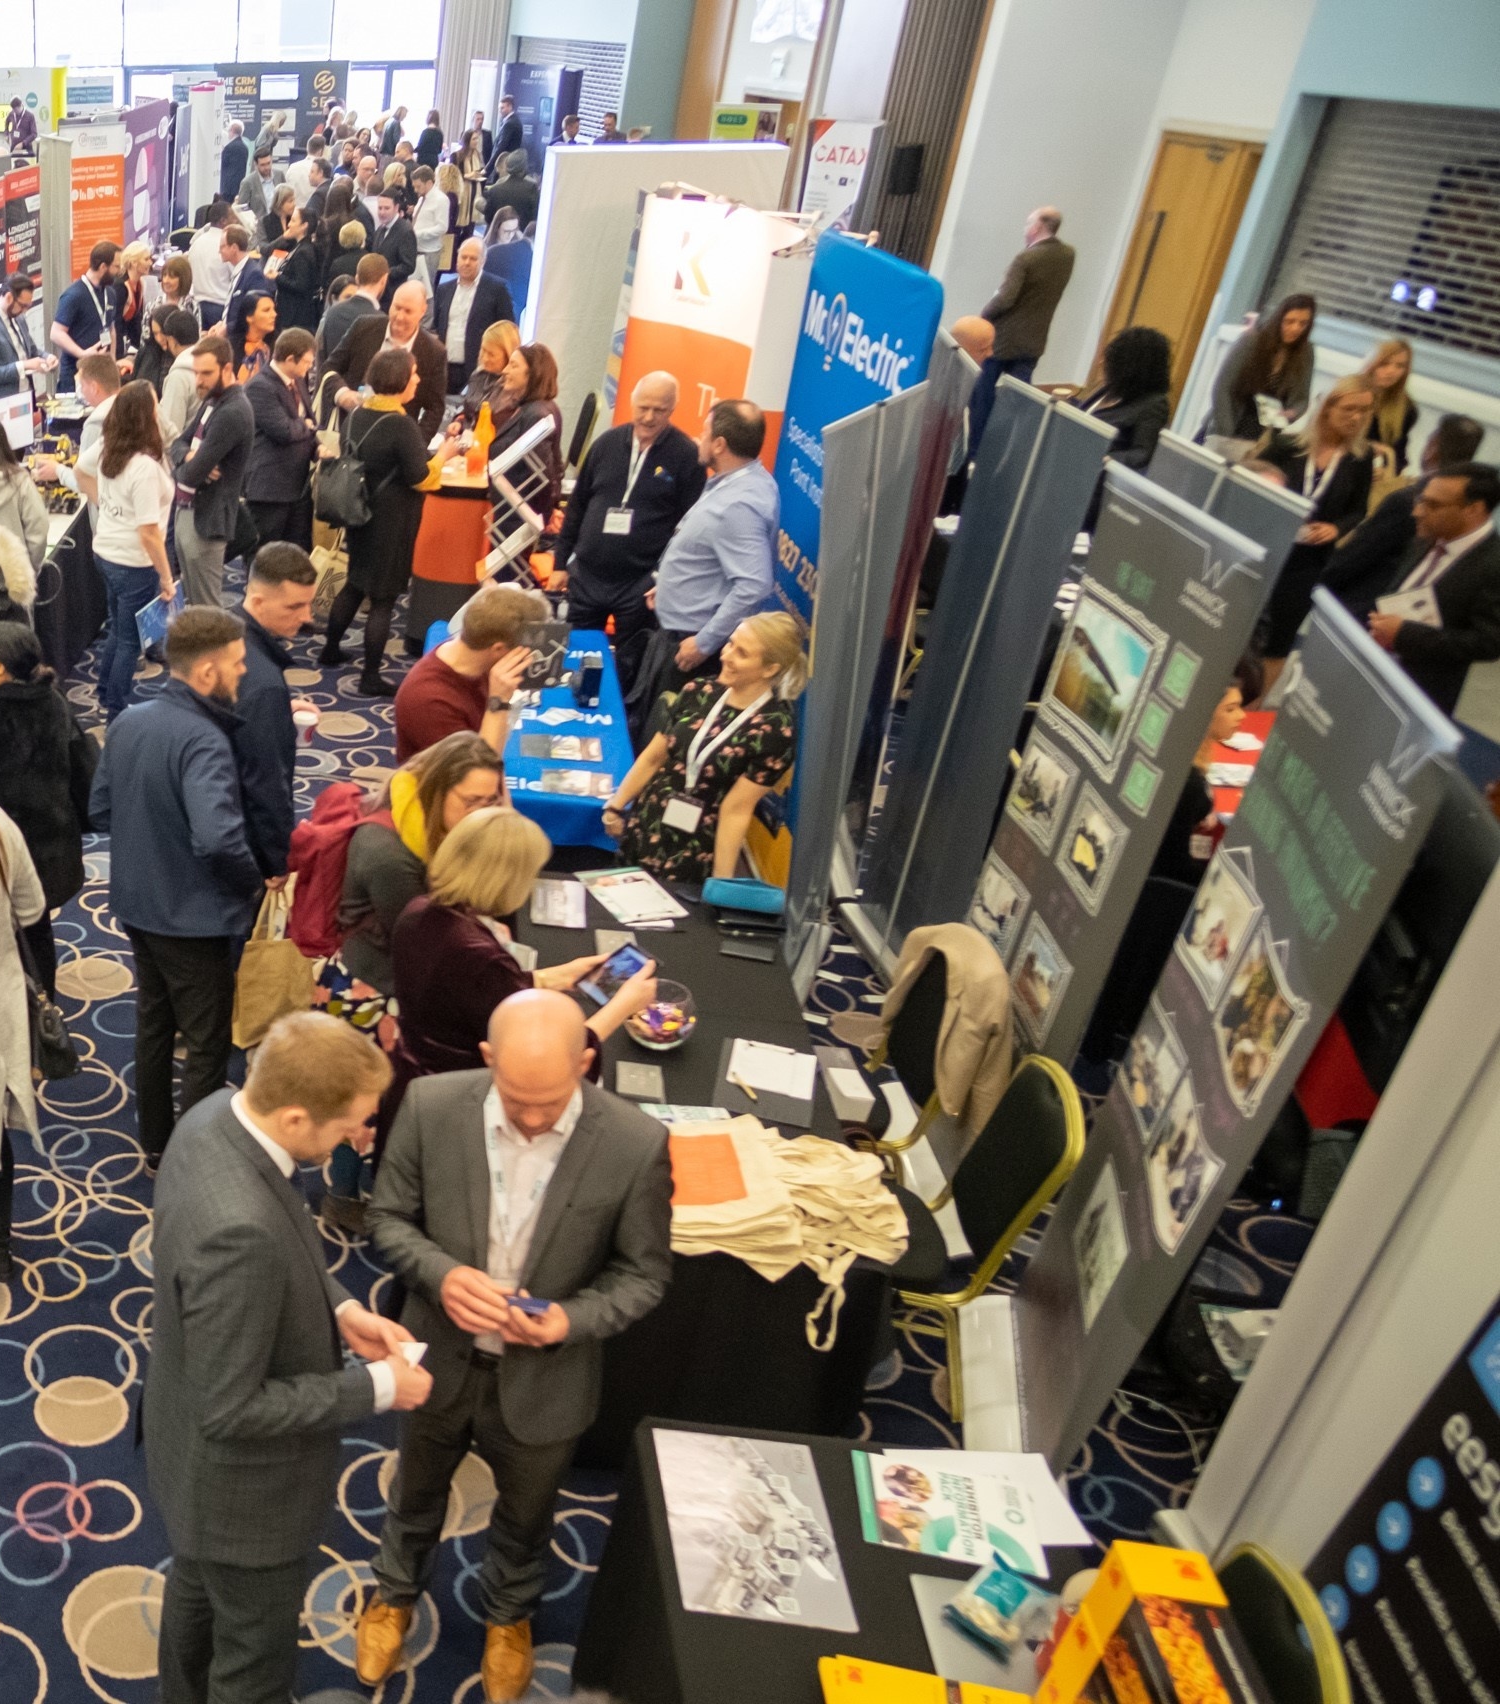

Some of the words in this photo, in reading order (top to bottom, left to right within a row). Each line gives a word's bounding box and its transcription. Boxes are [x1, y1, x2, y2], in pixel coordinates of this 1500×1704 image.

[235, 76, 256, 85] CRM
[9, 245, 36, 263] DEPARTMENT
[803, 289, 825, 346] Mr.
[838, 311, 911, 397] Electric
[937, 1470, 953, 1503] PACK
[961, 1475, 986, 1541] EXHIBITOR
[948, 1473, 978, 1558] INFORMATION
